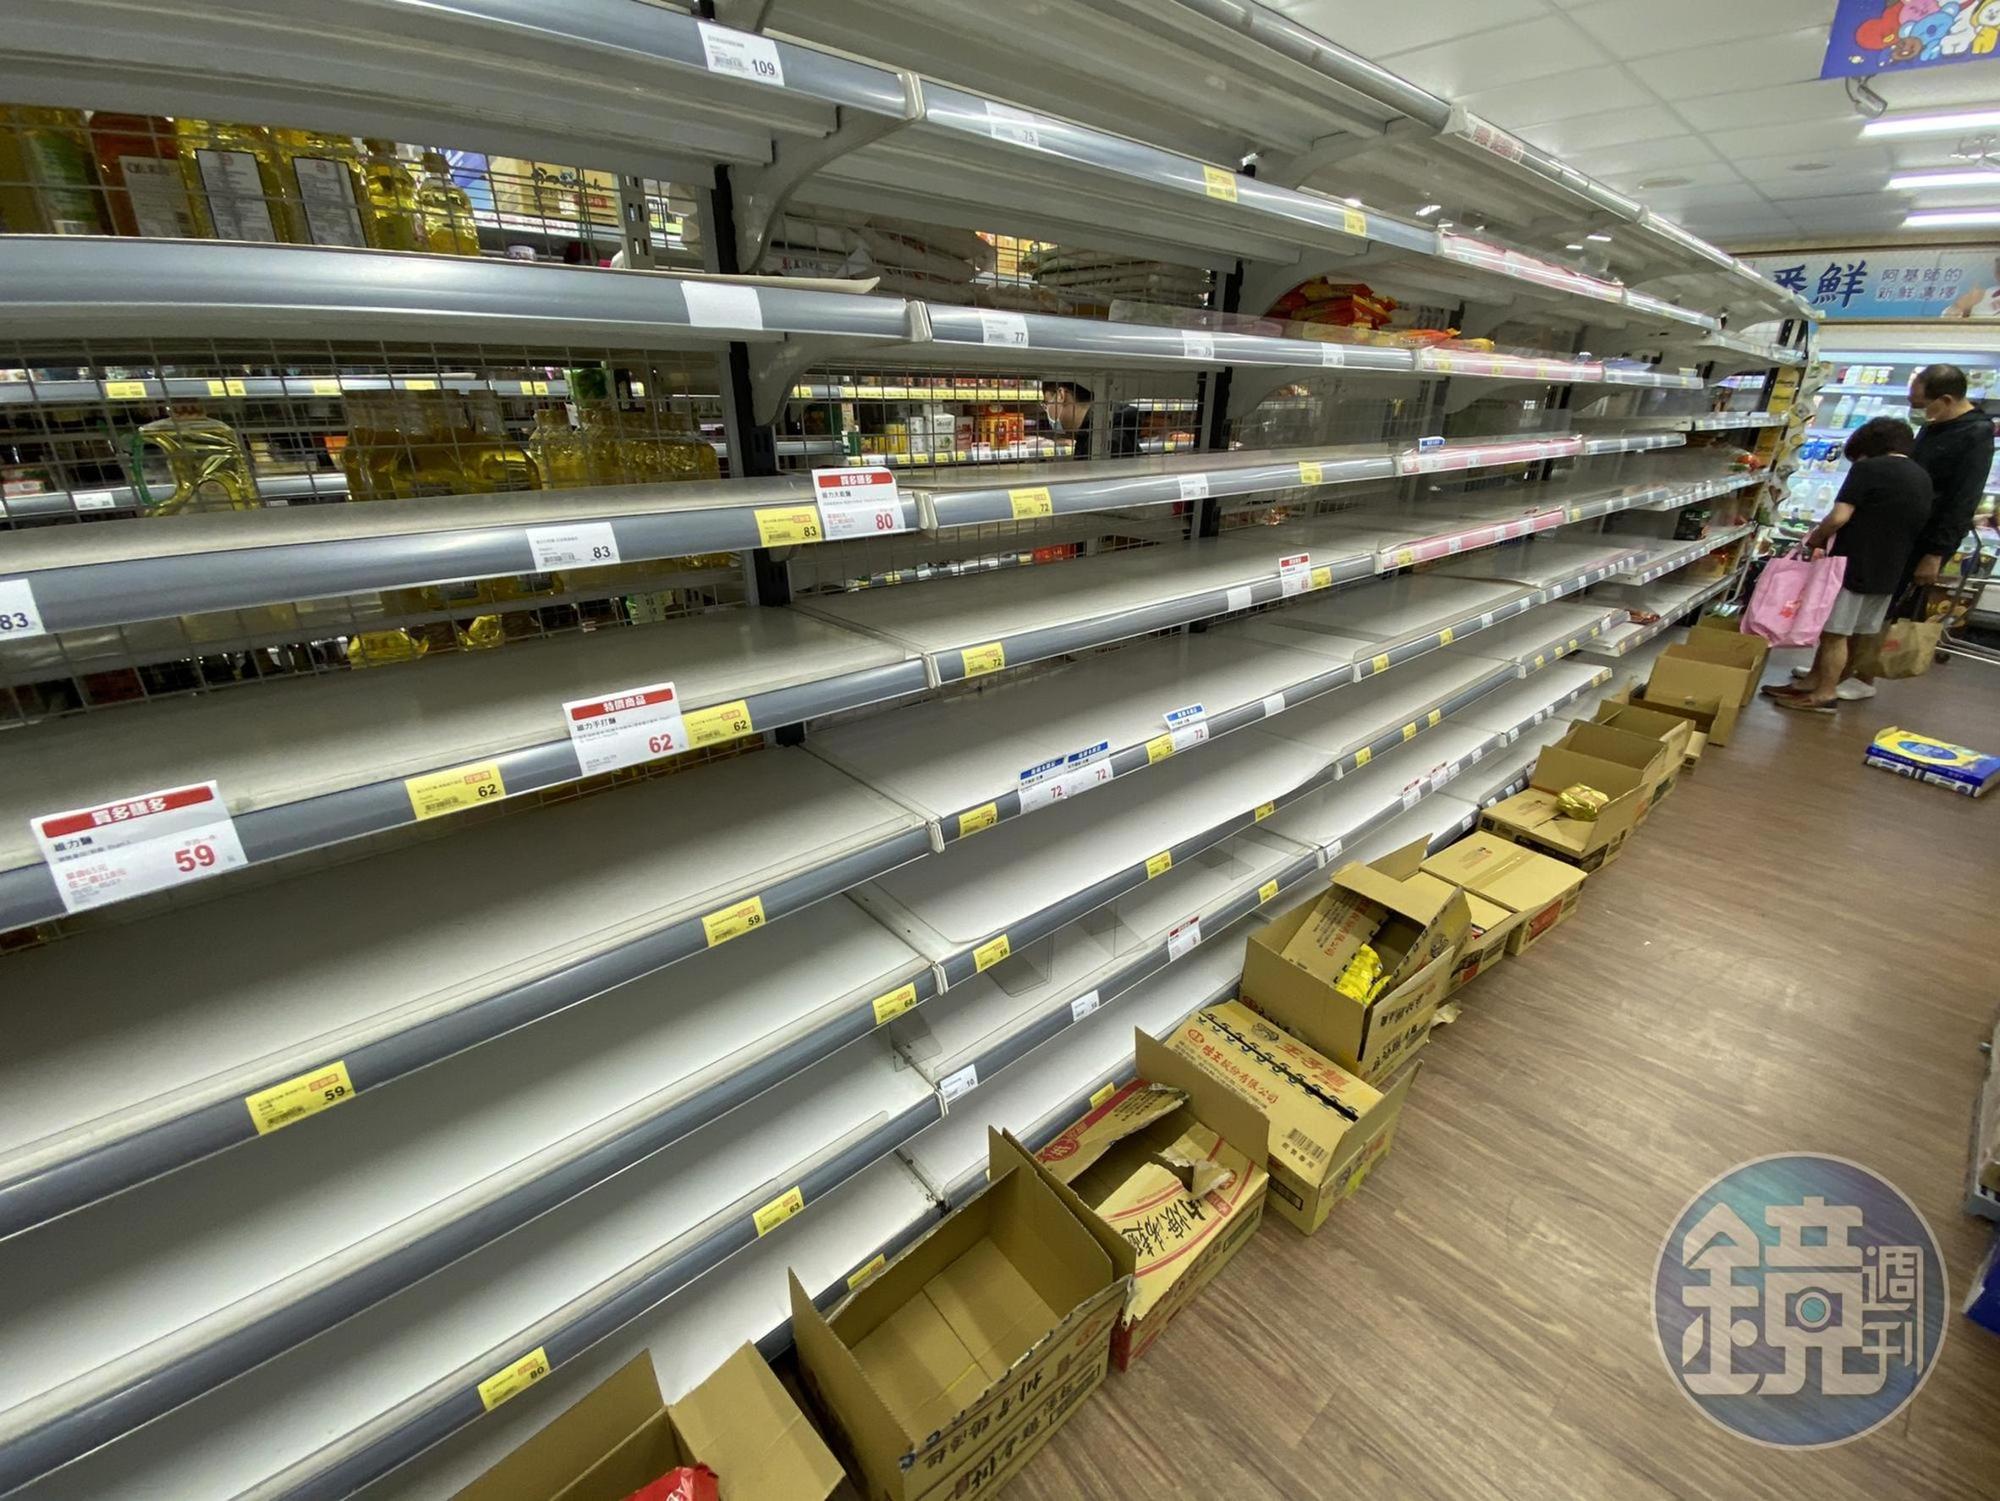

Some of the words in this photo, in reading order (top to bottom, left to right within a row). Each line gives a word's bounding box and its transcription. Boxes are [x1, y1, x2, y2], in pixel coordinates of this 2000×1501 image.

[752, 58, 776, 77] 109
[1015, 331, 1025, 343] 77
[1038, 503, 1051, 514] 72
[874, 512, 894, 531] 80
[803, 525, 818, 538] 83
[592, 545, 612, 560] 83
[0, 612, 29, 631] 83
[733, 719, 748, 732] 62
[648, 733, 674, 754] 62
[1095, 768, 1107, 781] 72
[477, 783, 498, 798] 62
[1050, 785, 1063, 799] 72
[174, 843, 217, 873] 59
[748, 914, 760, 926] 59
[324, 1085, 346, 1102] 59
[530, 1365, 545, 1380] 80
